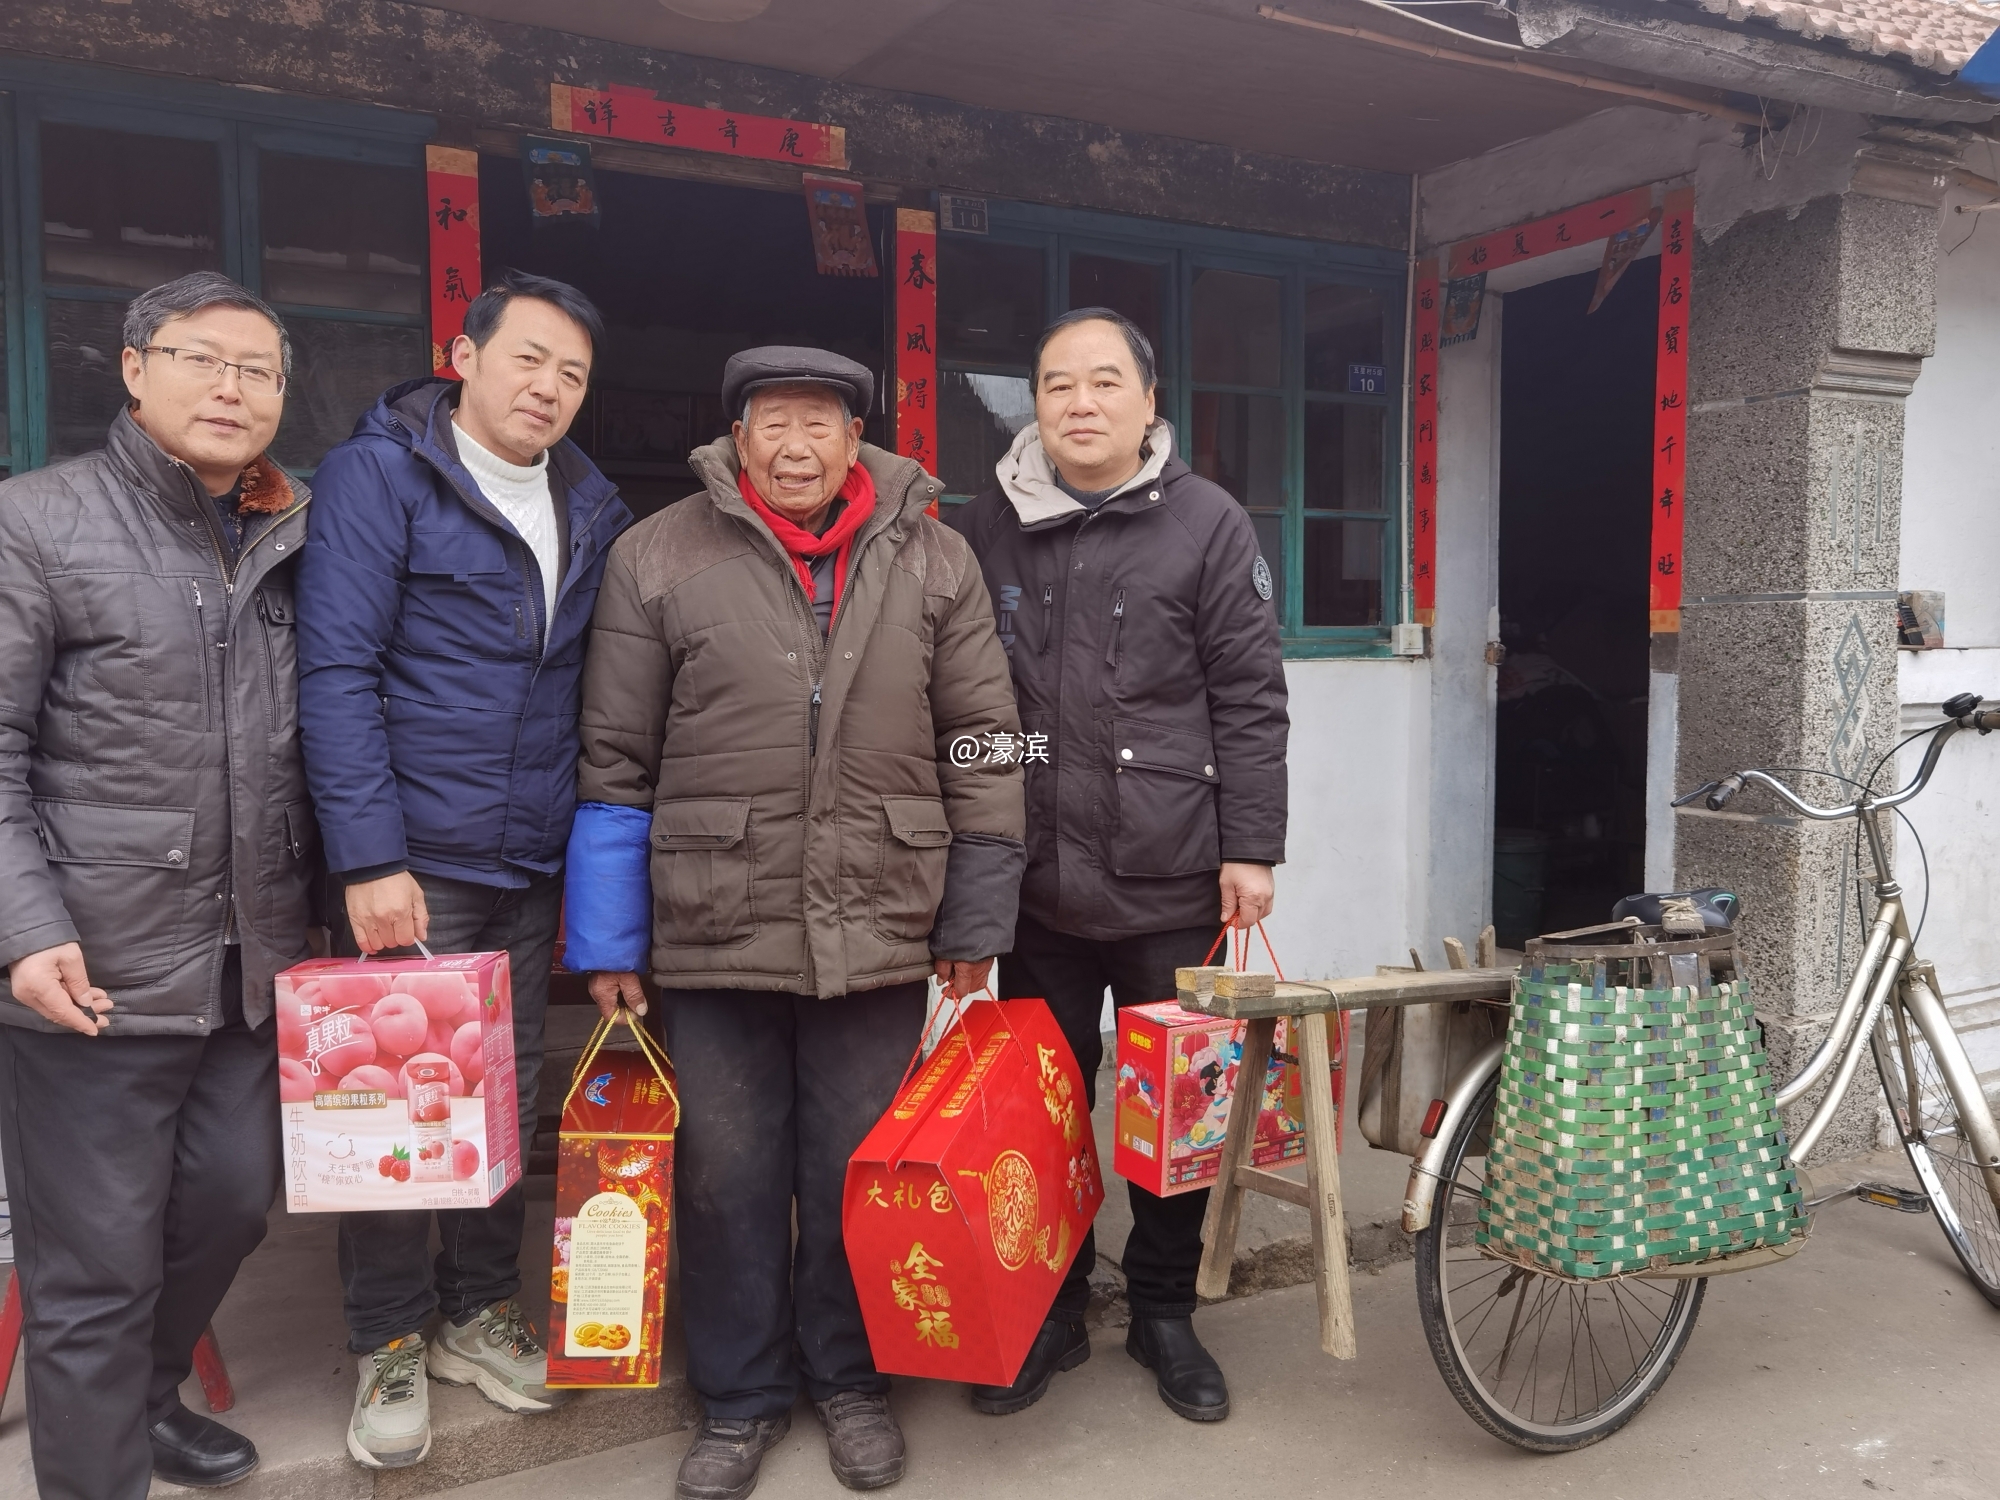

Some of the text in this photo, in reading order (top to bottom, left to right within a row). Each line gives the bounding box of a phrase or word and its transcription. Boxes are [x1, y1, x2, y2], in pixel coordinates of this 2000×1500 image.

[960, 211, 979, 228] 10
[903, 249, 935, 463] 春風得意
[1360, 378, 1375, 392] 10
[305, 1014, 353, 1058] 真果粒
[315, 1093, 386, 1107] 高端缤纷果粒系列
[290, 1106, 308, 1207] 牛奶饮品
[864, 1180, 953, 1213] 大礼包
[587, 1204, 633, 1217] Cookies
